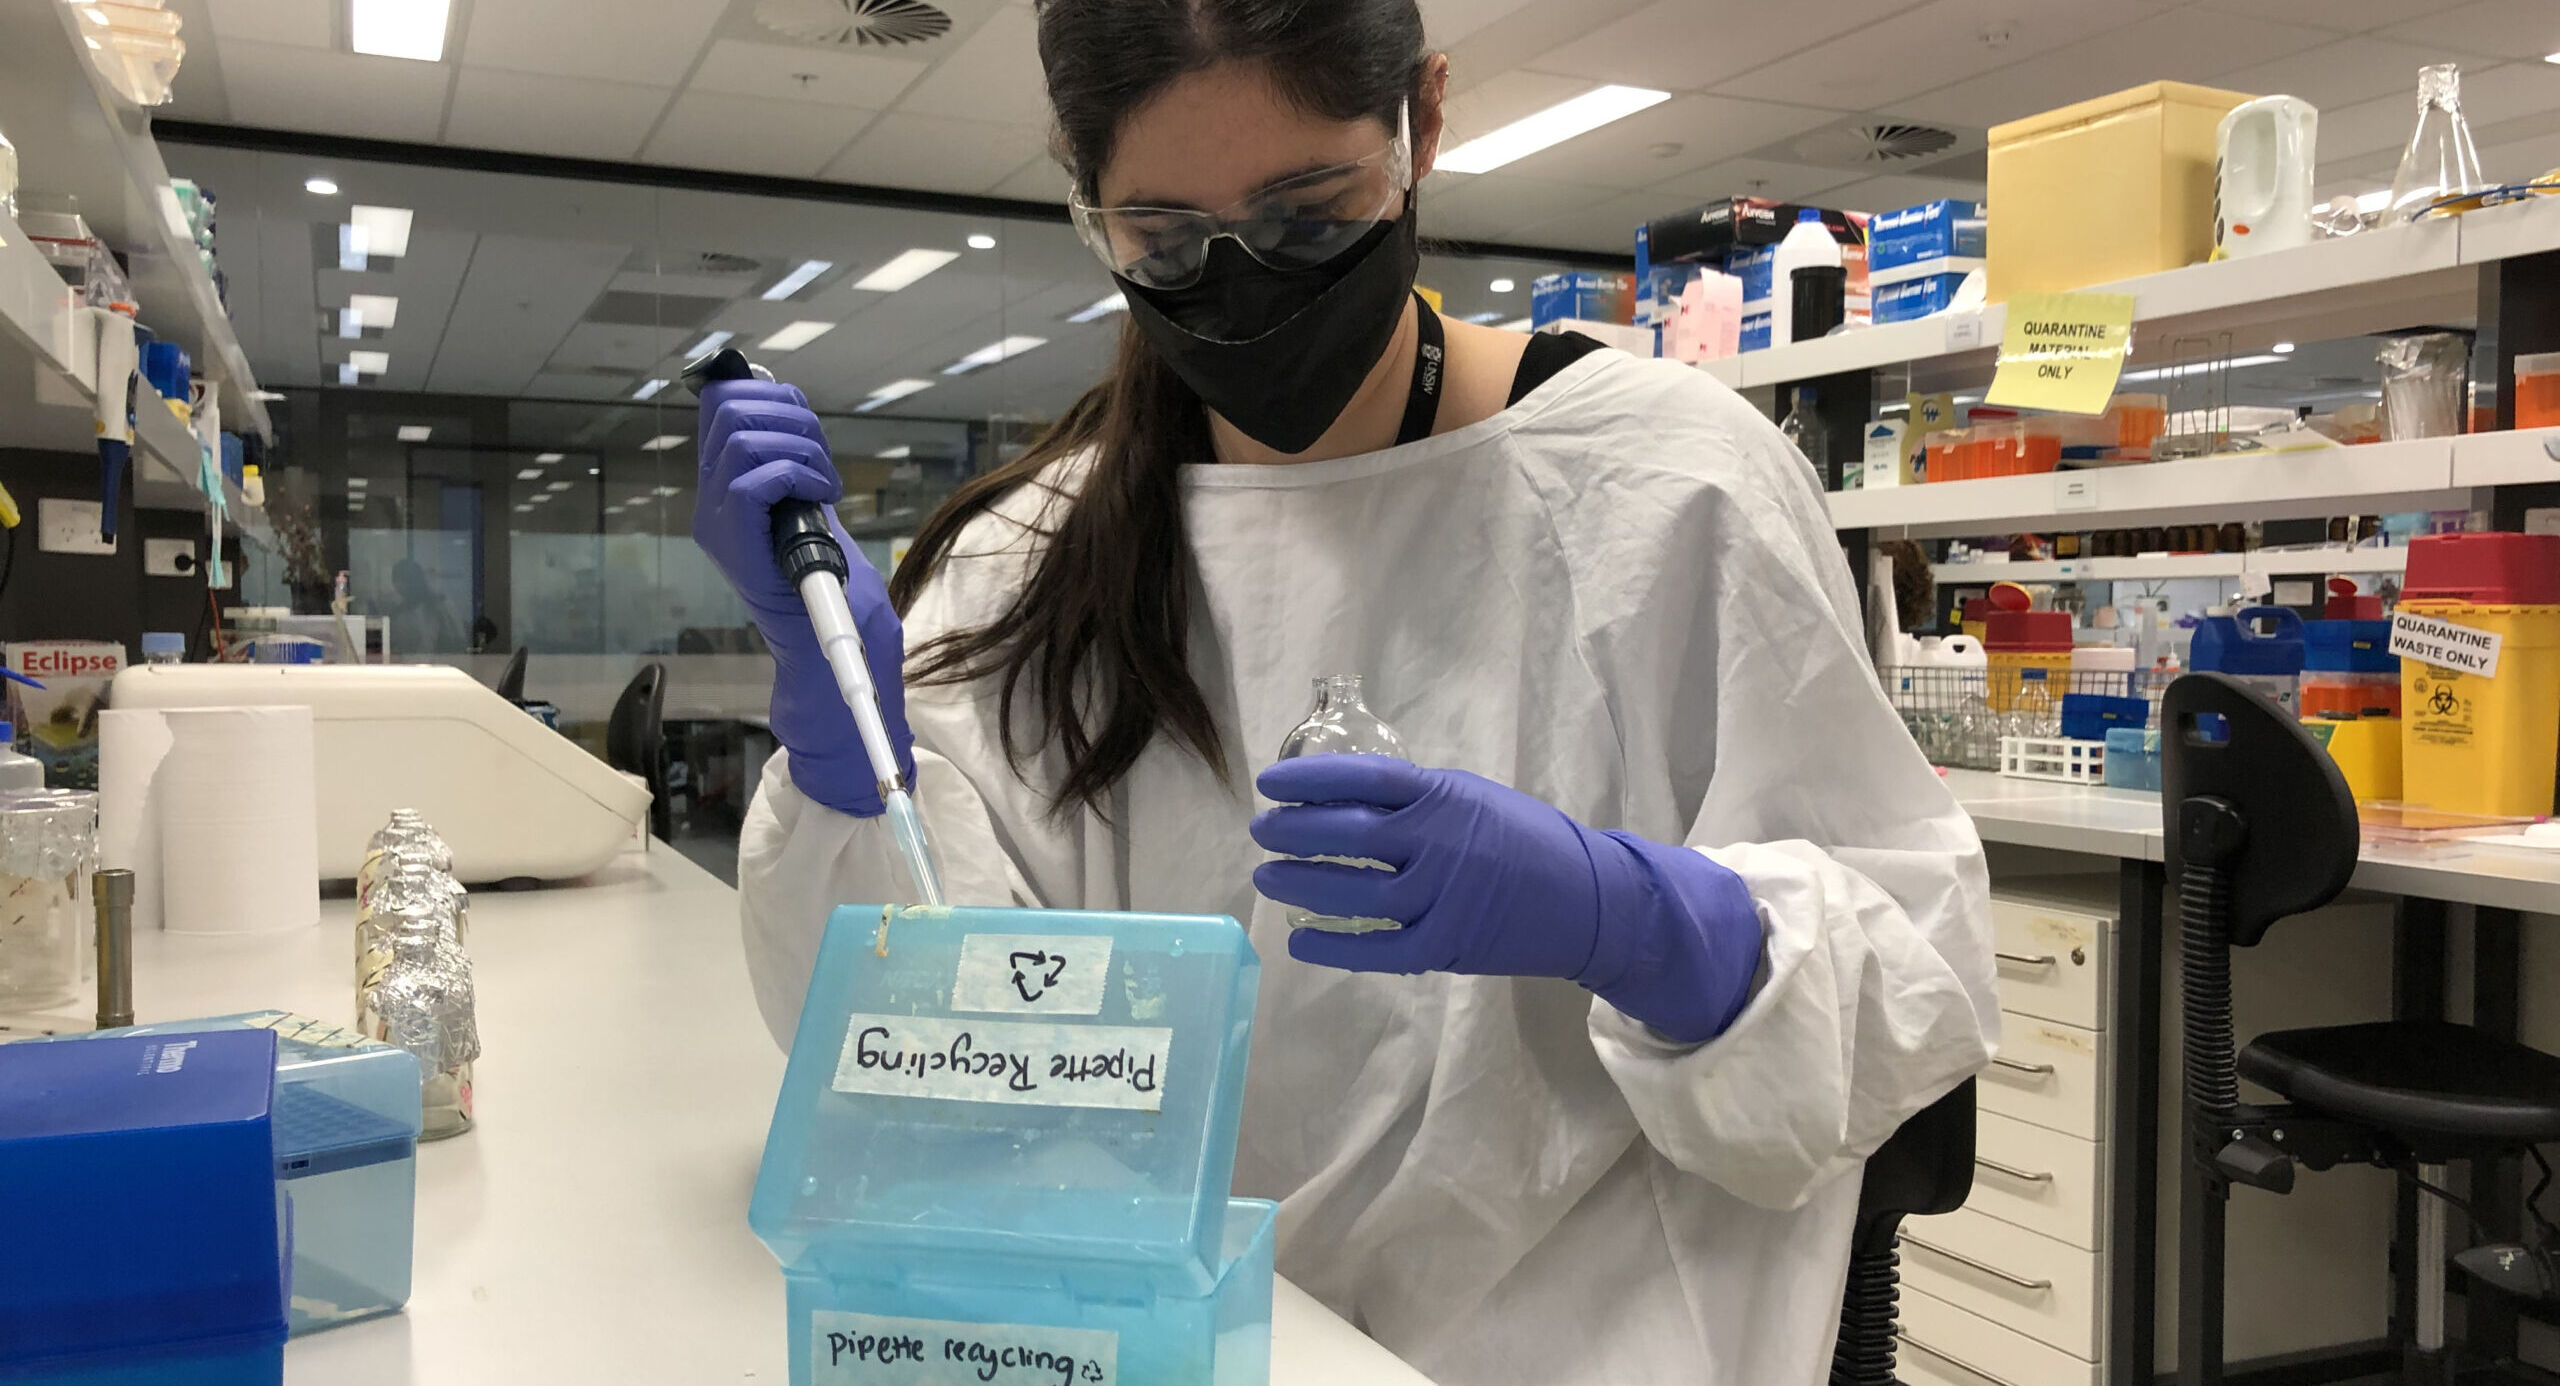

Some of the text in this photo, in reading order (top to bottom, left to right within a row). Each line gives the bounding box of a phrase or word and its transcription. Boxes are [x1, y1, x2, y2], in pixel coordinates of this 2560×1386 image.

[2023, 321, 2106, 339] QUARANTINE
[1424, 361, 1438, 395] UNSW
[2038, 364, 2073, 380] ONLY
[2396, 616, 2492, 650] QUARANTINE
[23, 650, 117, 676] Eclipse
[2394, 636, 2488, 670] WASTE ONLY
[857, 1027, 1156, 1092] Pipette Recycling
[827, 1331, 925, 1366] pipette
